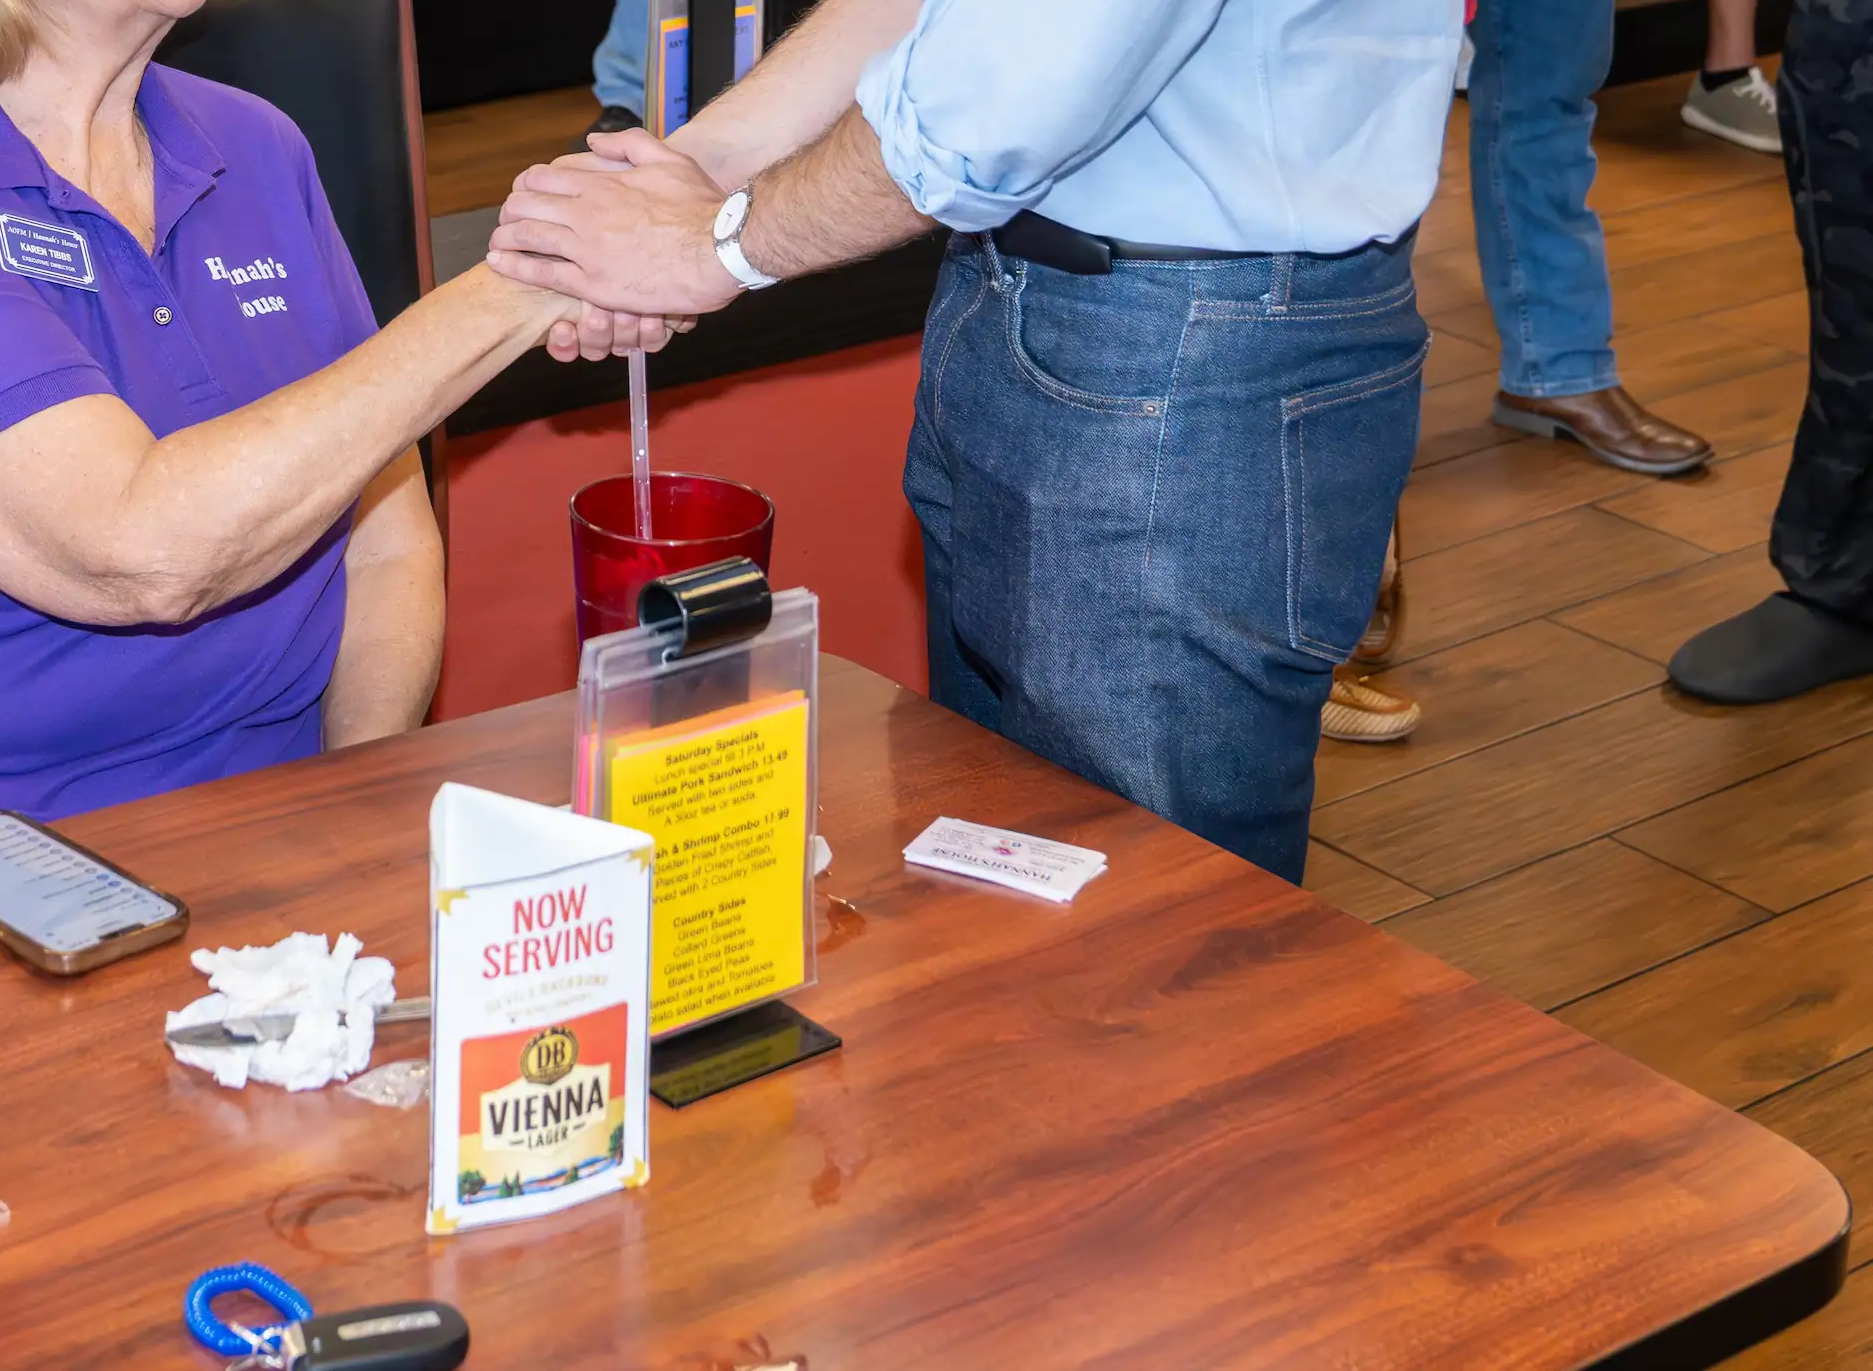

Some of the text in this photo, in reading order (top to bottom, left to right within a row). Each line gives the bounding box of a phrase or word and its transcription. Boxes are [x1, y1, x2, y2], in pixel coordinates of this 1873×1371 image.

[19, 242, 72, 262] KAREN TIBBS
[204, 256, 287, 285] Hnah's
[234, 293, 287, 318] ouse
[666, 731, 759, 765] Saturday Specials
[633, 787, 677, 805] Ultimate
[682, 778, 705, 791] Pork
[709, 761, 758, 781] Sandwich
[655, 768, 686, 784] Lunch
[648, 768, 774, 817] Served with two sides and
[702, 803, 716, 816] tea
[684, 832, 721, 850] Shrimp
[725, 819, 760, 837] Combo
[692, 848, 717, 862] Fried
[721, 836, 754, 854] Shrimp
[757, 827, 774, 841] and
[653, 891, 677, 905] rved
[681, 883, 700, 895] with
[712, 868, 748, 886] Country
[752, 857, 777, 871] Sides
[705, 857, 734, 875] Crispy
[514, 884, 588, 933] NOW
[674, 897, 746, 927] Country Sides
[674, 927, 746, 958] Collard Greens
[679, 913, 742, 941] Green Beans
[482, 918, 614, 980] SERVING
[665, 938, 754, 975] Green Lima Beans
[669, 973, 695, 988] Black
[699, 963, 722, 978] Eyed
[650, 975, 775, 1025] otato salad when available
[651, 993, 680, 1009] tewed
[708, 975, 726, 990] and
[537, 1040, 567, 1070] DB
[489, 1076, 605, 1136] VIENNA
[528, 1127, 568, 1150] LAGER
